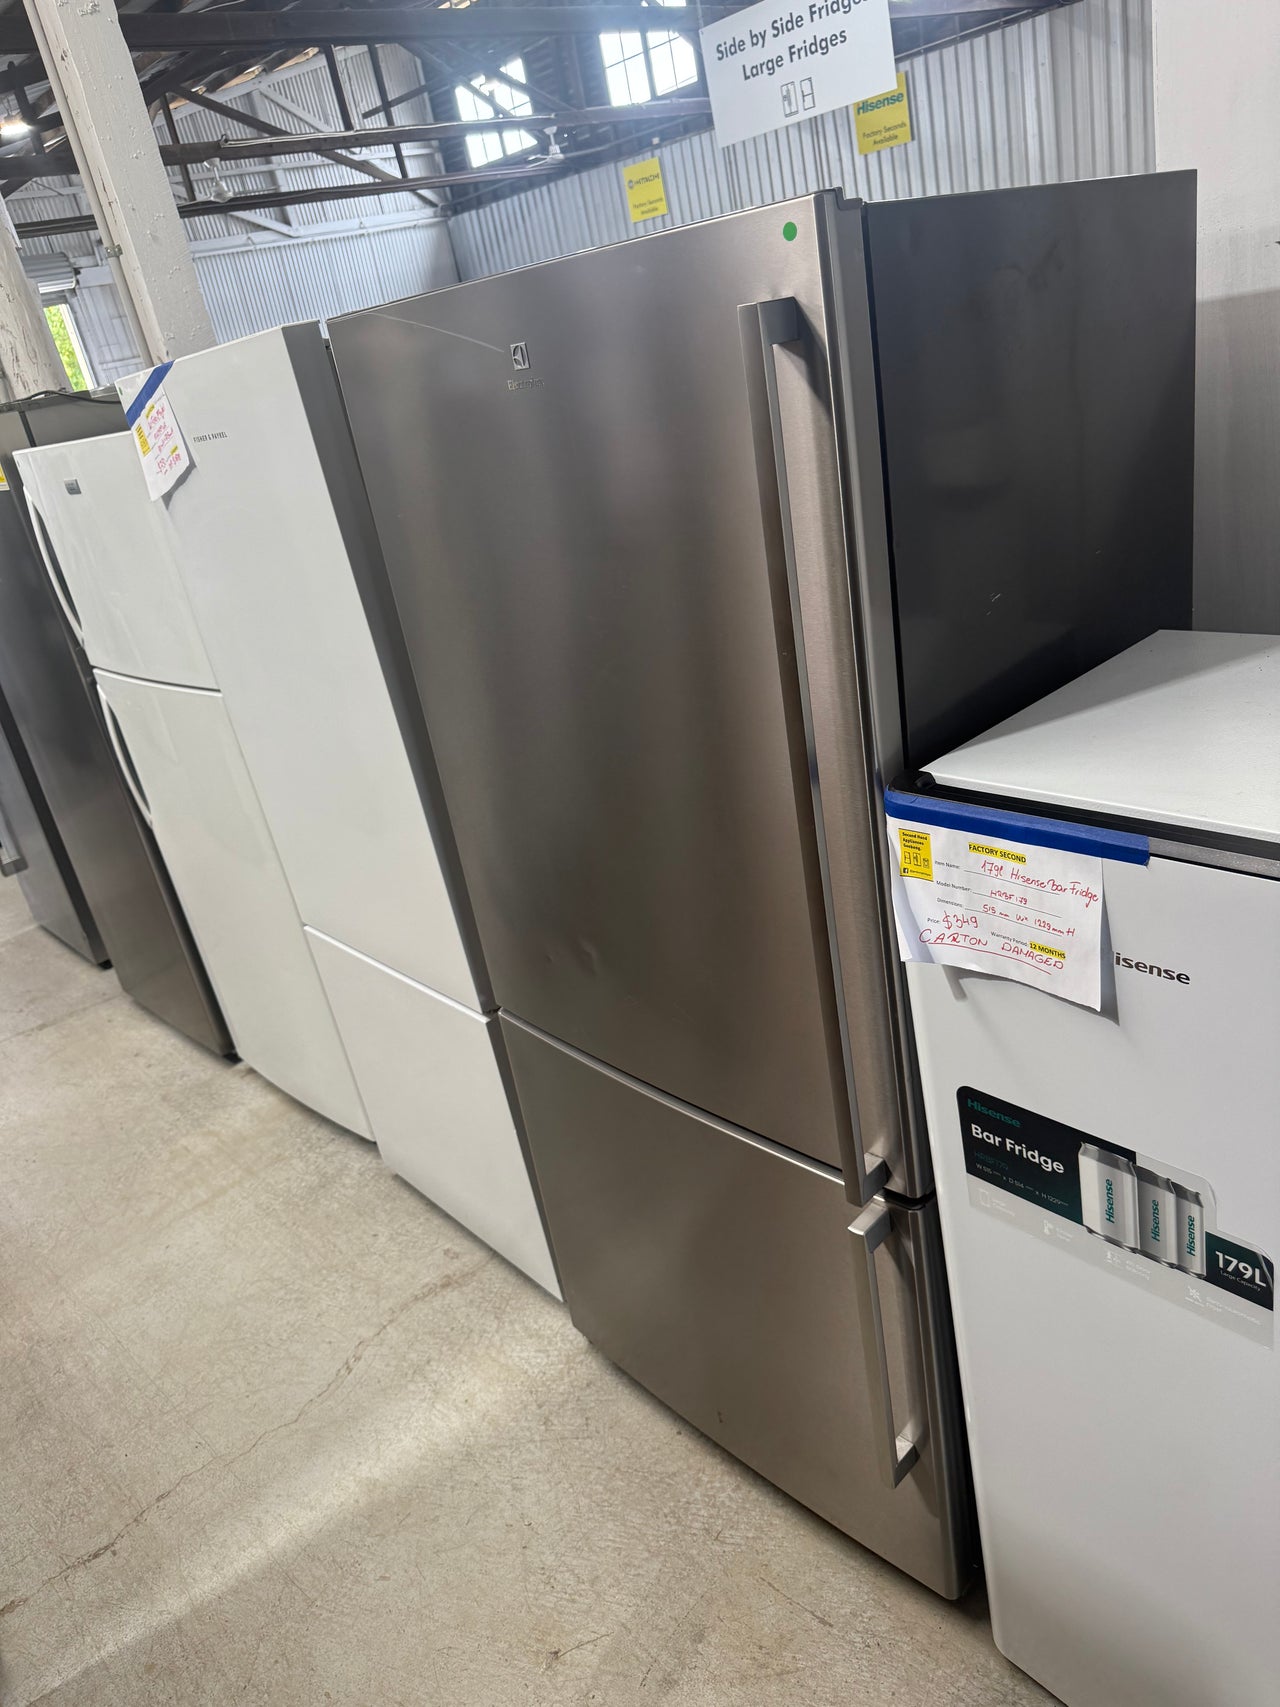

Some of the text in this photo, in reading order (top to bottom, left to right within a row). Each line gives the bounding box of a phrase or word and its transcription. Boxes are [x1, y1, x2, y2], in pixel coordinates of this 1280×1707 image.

[716, 37, 746, 61] Side
[749, 29, 767, 48] by
[771, 12, 804, 39] Side
[742, 30, 848, 81] Large Fridges
[857, 92, 904, 116] Hisense
[969, 844, 1026, 863] FACTORY SECOND
[936, 880, 951, 888] Model
[1010, 867, 1047, 889] Hisense
[1047, 879, 1067, 893] Bar
[1070, 881, 1099, 908] Fridge
[942, 910, 978, 930] $349
[919, 928, 1064, 970] CARTON DAMAGED
[991, 931, 1012, 942] Warranty
[1038, 945, 1066, 960] MONTHS
[1115, 952, 1191, 985] isense
[967, 1098, 1022, 1128] Hisense
[971, 1123, 1065, 1175] Bar Fridge
[1105, 1178, 1115, 1224] Hisense
[1151, 1199, 1161, 1242] Hisense
[1186, 1215, 1196, 1257] Hisense
[1215, 1250, 1267, 1287] 179L
[1220, 1270, 1261, 1292] Large Capacity
